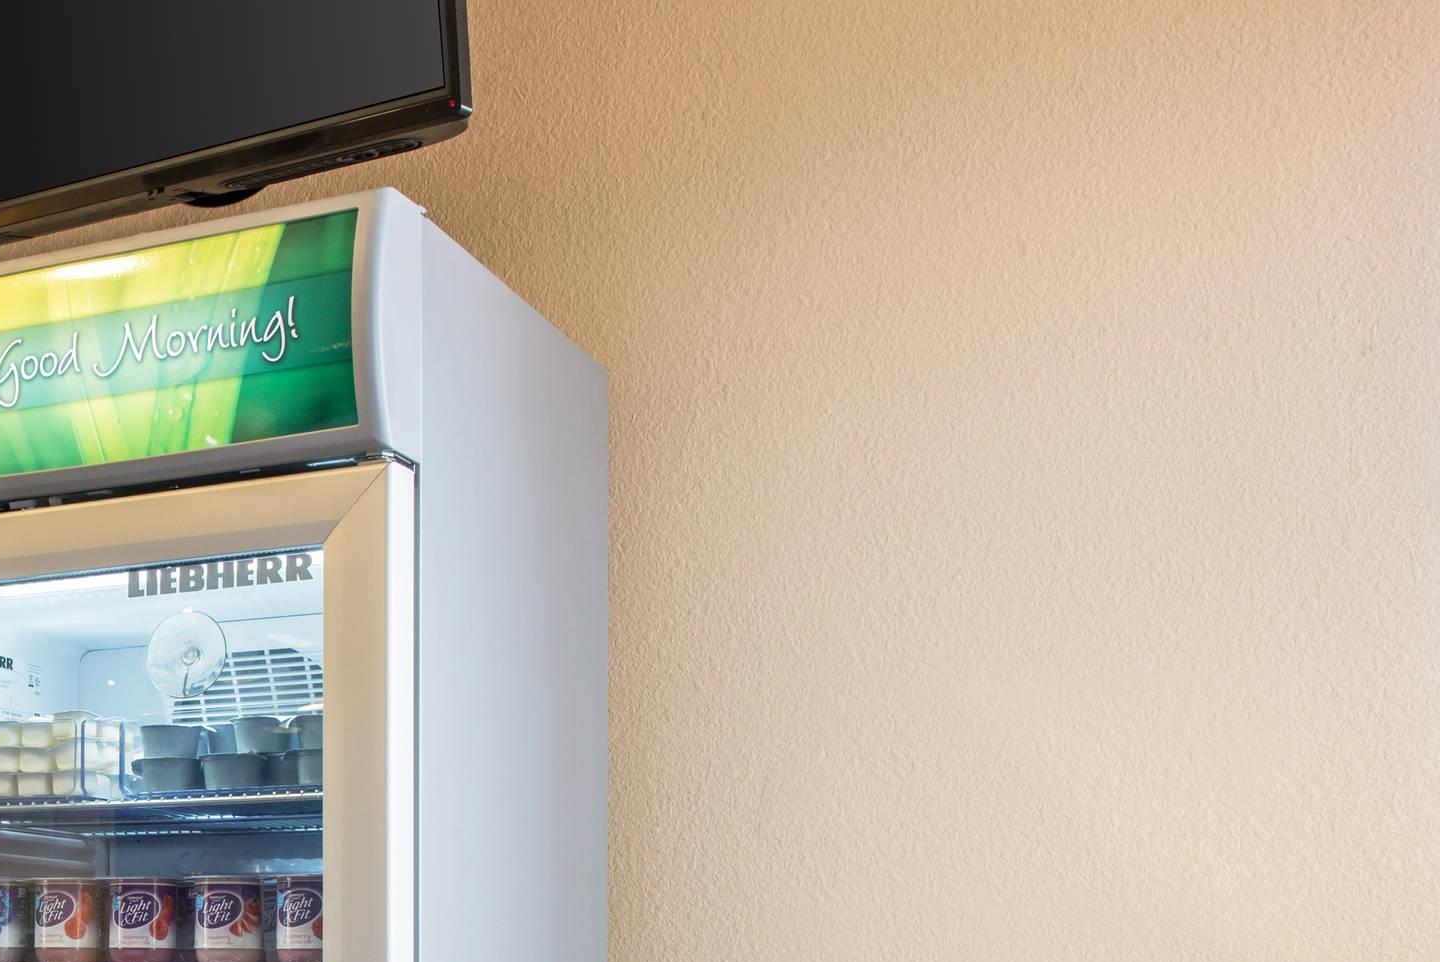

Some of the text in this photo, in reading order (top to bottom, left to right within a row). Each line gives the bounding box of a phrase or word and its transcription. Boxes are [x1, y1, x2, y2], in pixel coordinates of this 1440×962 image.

[92, 295, 298, 379] Morning!
[128, 554, 313, 598] LIEBHERR
[39, 898, 66, 915] Light
[120, 899, 151, 916] Light
[203, 899, 234, 915] Light
[283, 897, 313, 914] Light
